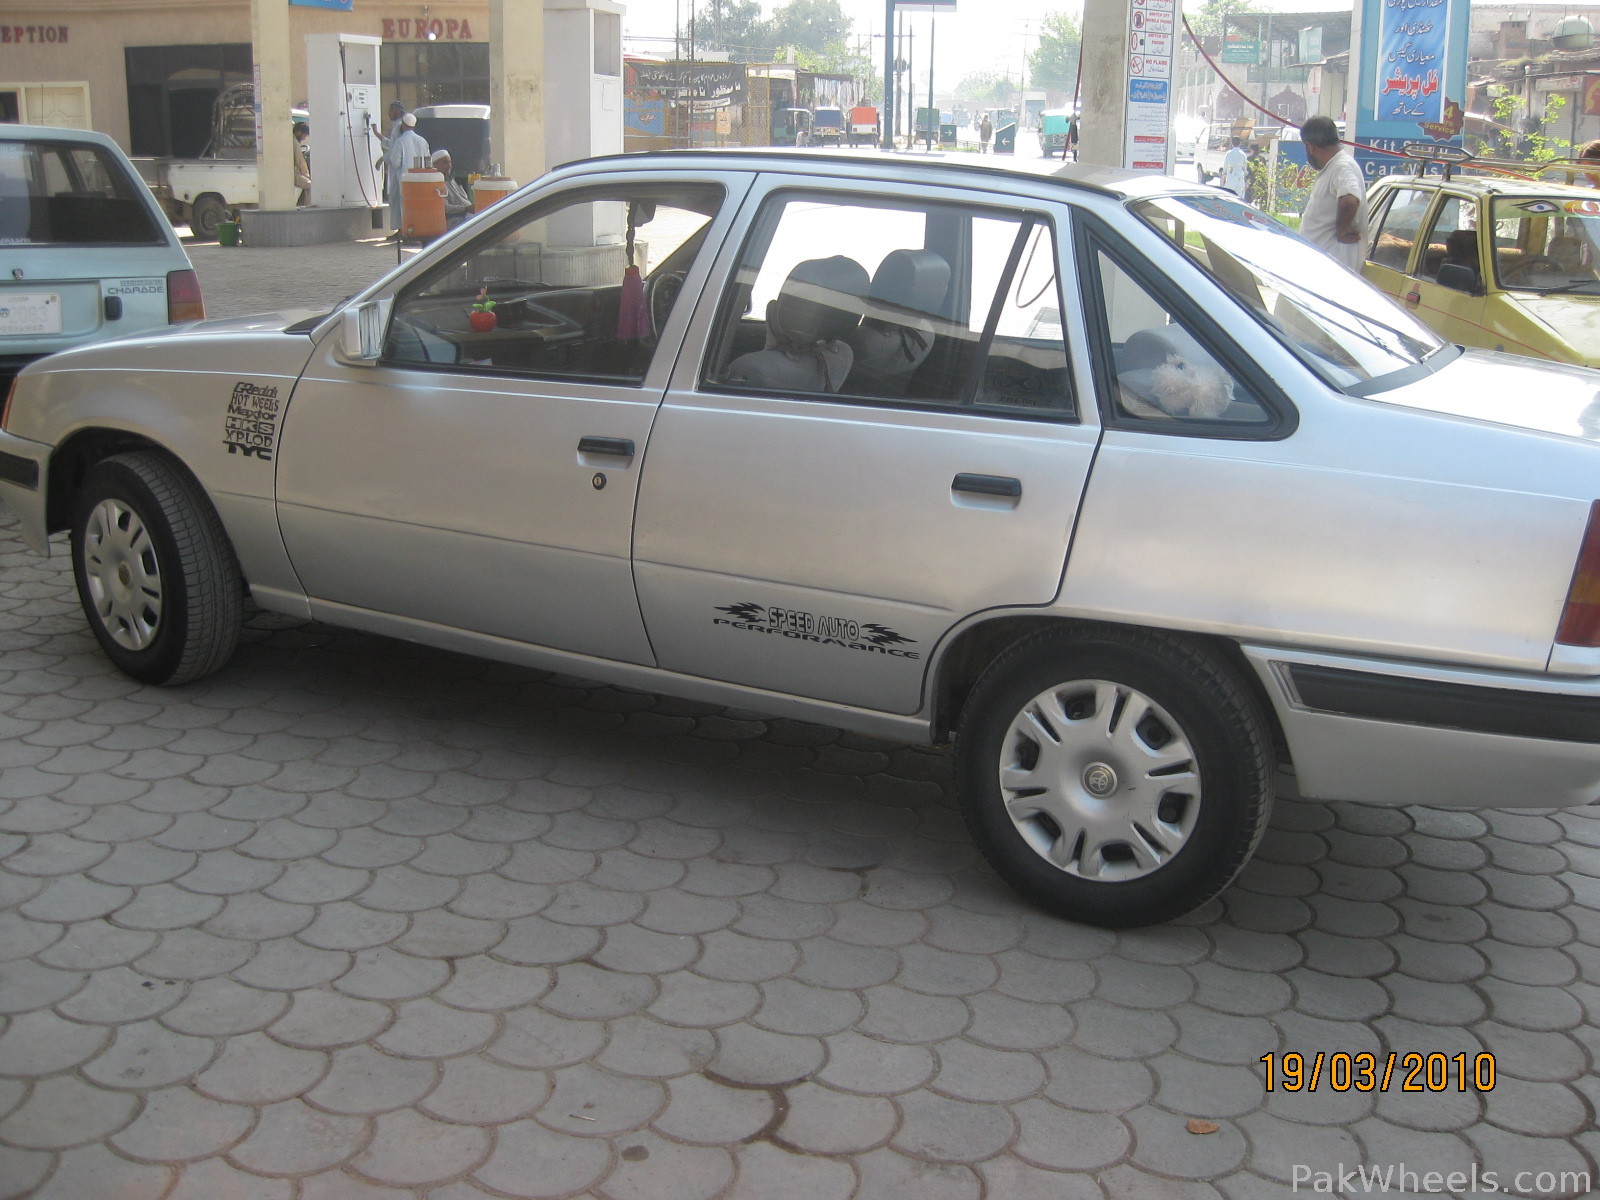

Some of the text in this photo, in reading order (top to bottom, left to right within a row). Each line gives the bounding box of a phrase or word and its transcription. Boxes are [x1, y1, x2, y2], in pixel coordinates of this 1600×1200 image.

[1, 26, 69, 43] EPTION
[382, 18, 472, 39] EUROPA
[1395, 24, 1407, 33] اور
[1421, 69, 1438, 96] فل
[1423, 122, 1455, 135] Service
[1365, 161, 1397, 176] Car
[108, 287, 164, 295] CHARADE
[231, 392, 250, 406] HOT
[227, 404, 277, 421] Maxtor
[225, 416, 275, 436] HKS
[225, 429, 273, 447] XPLOD
[223, 440, 273, 461] TYC
[768, 607, 860, 641] SPEED AUTO
